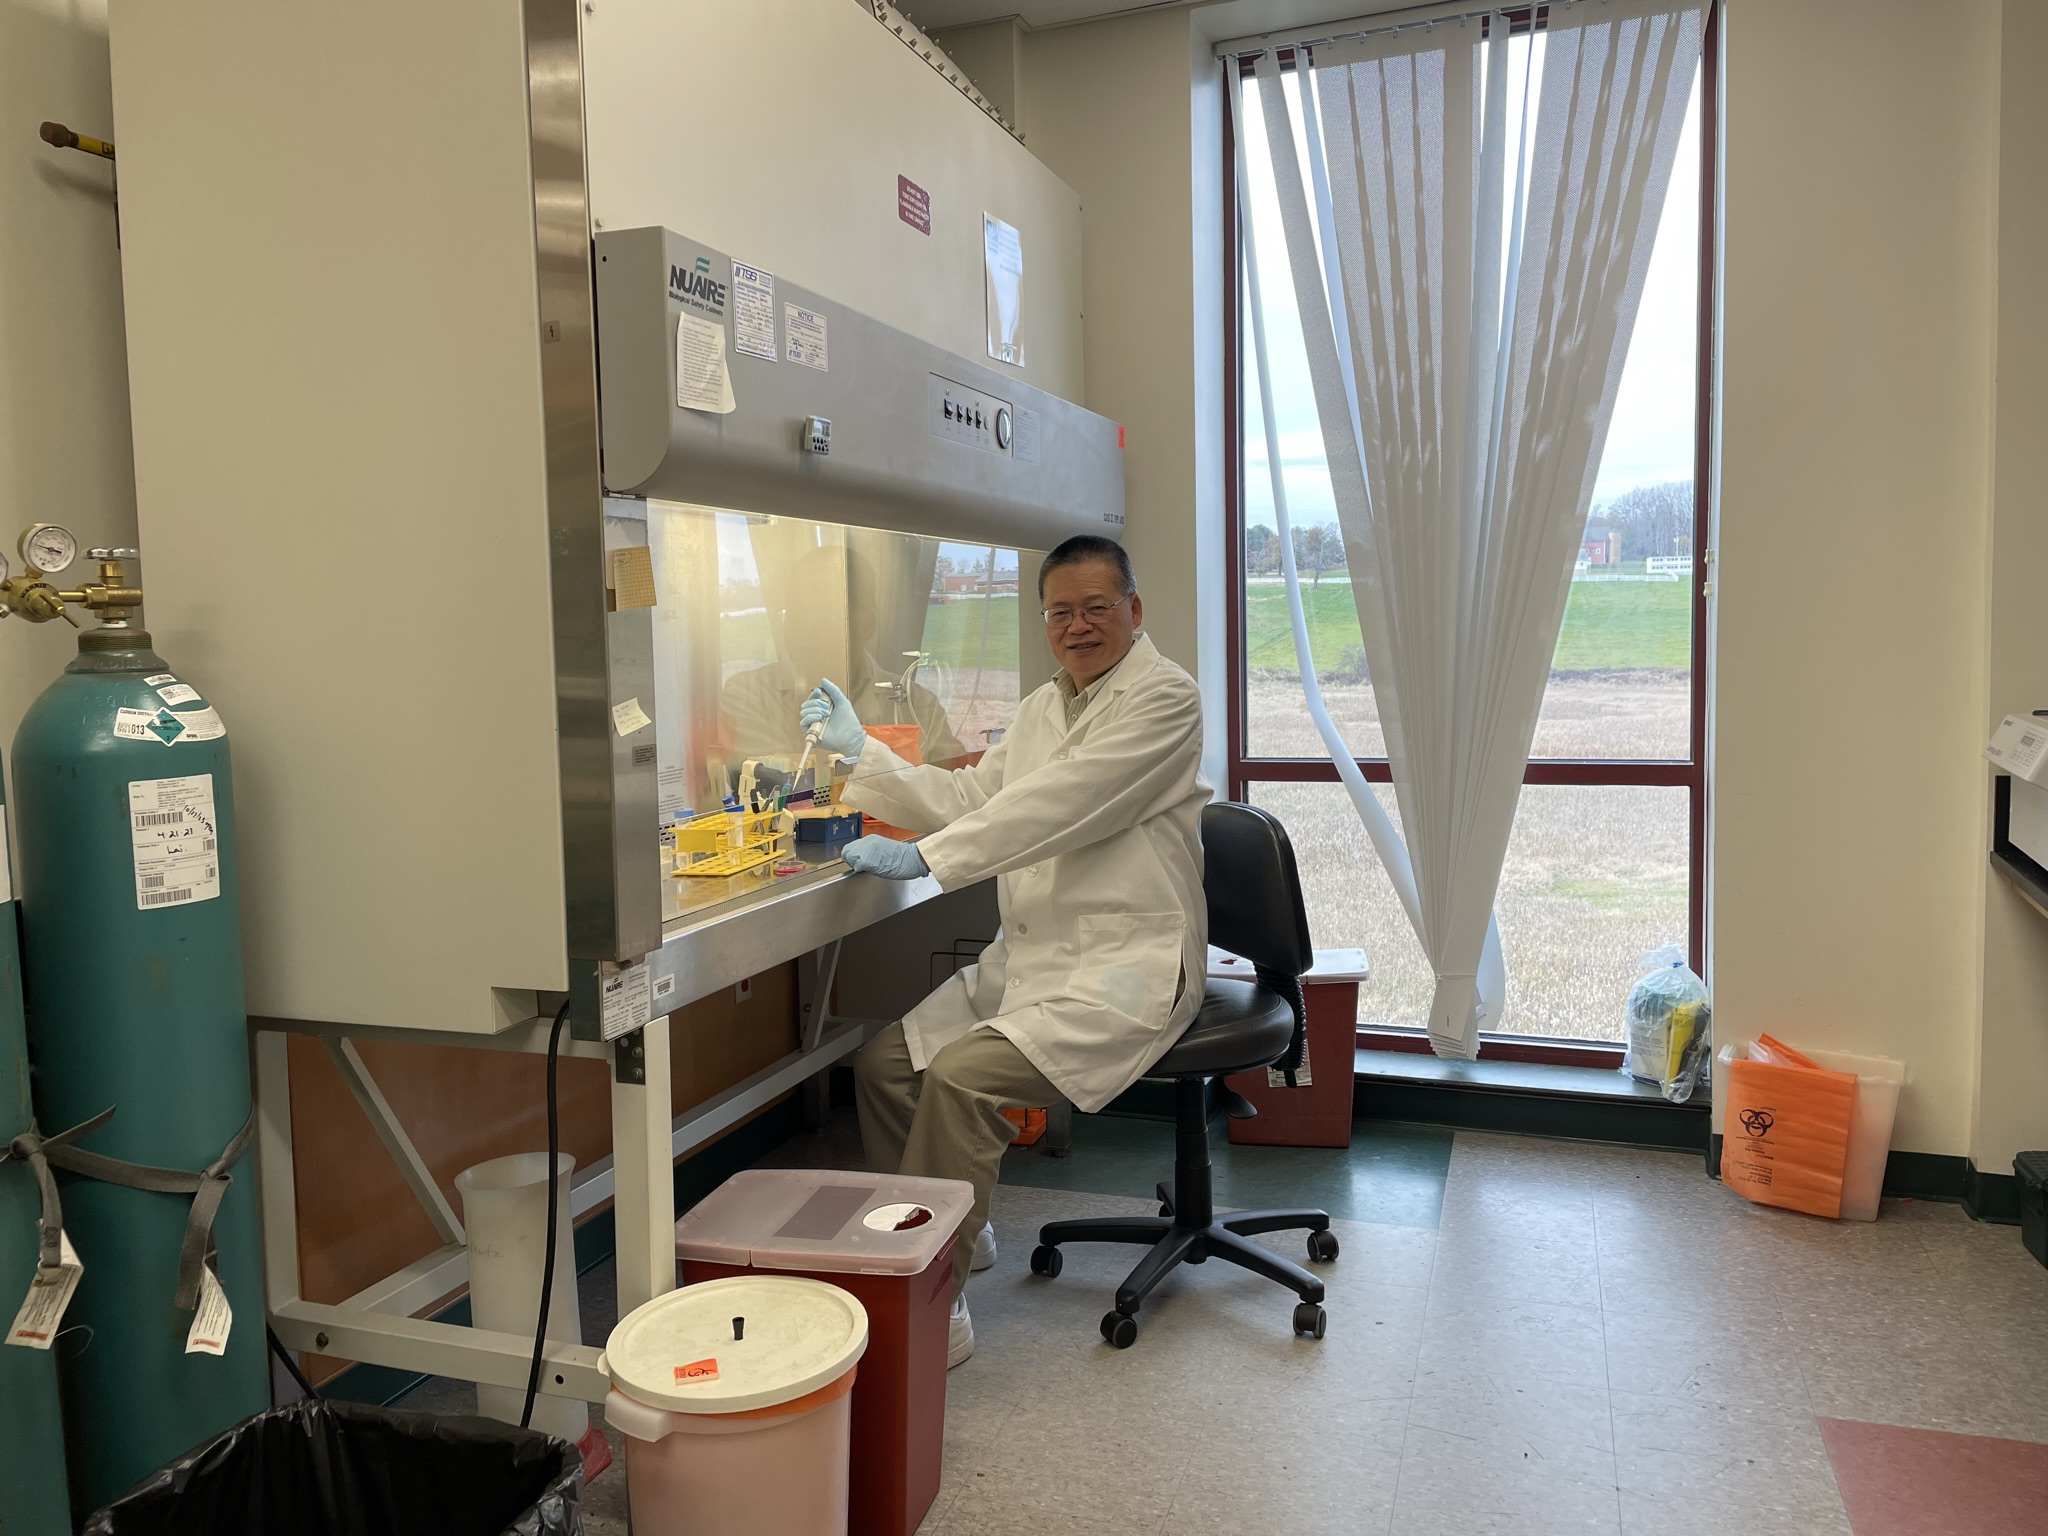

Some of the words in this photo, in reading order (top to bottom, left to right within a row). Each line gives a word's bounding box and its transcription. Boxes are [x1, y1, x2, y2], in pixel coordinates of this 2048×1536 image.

[669, 264, 726, 307] NUAIRE
[669, 290, 690, 304] Biological
[690, 298, 705, 311] Safety
[705, 304, 724, 317] Cabinets
[797, 310, 814, 324] NOTICE
